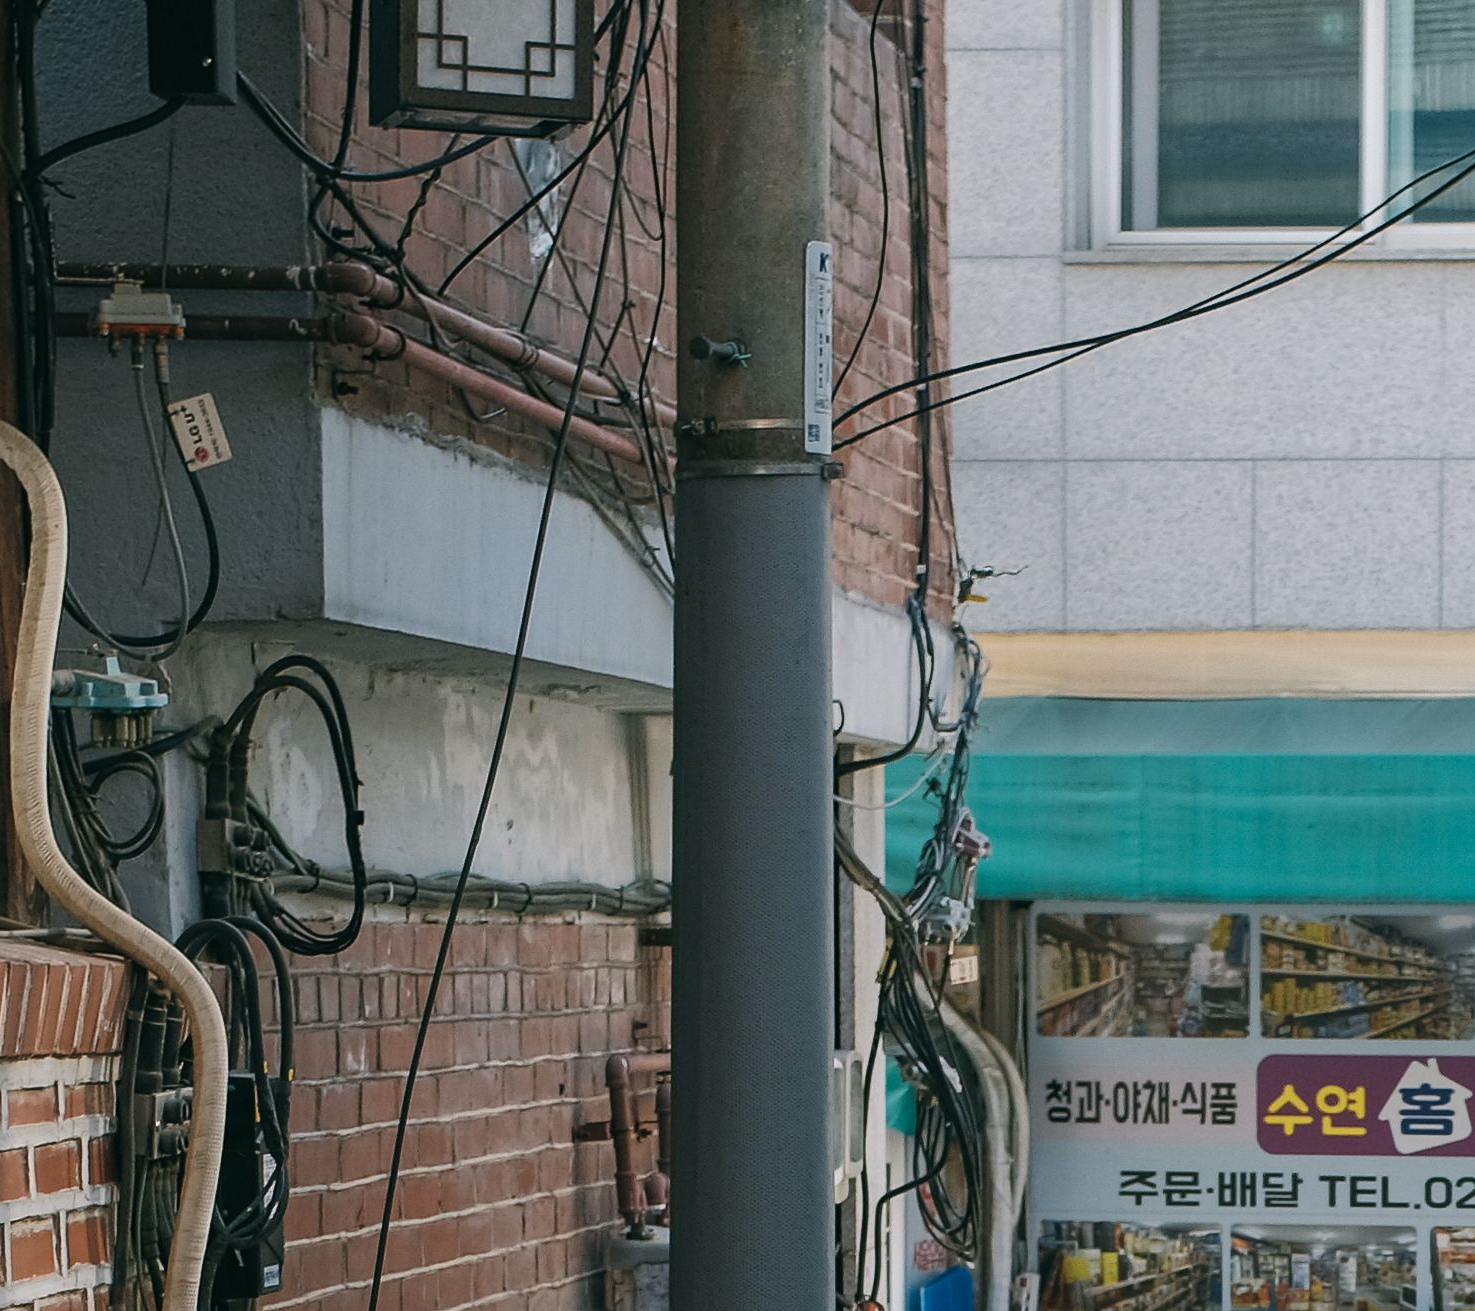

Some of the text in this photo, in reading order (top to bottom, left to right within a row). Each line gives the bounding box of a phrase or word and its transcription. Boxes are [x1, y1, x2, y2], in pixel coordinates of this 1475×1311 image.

[189, 425, 203, 445] LG
[1045, 1079, 1238, 1125] 청과·야채·식품
[1263, 1083, 1367, 1136] 수연
[1399, 1082, 1456, 1136] 홈
[1118, 1170, 1304, 1208] 주문·배달
